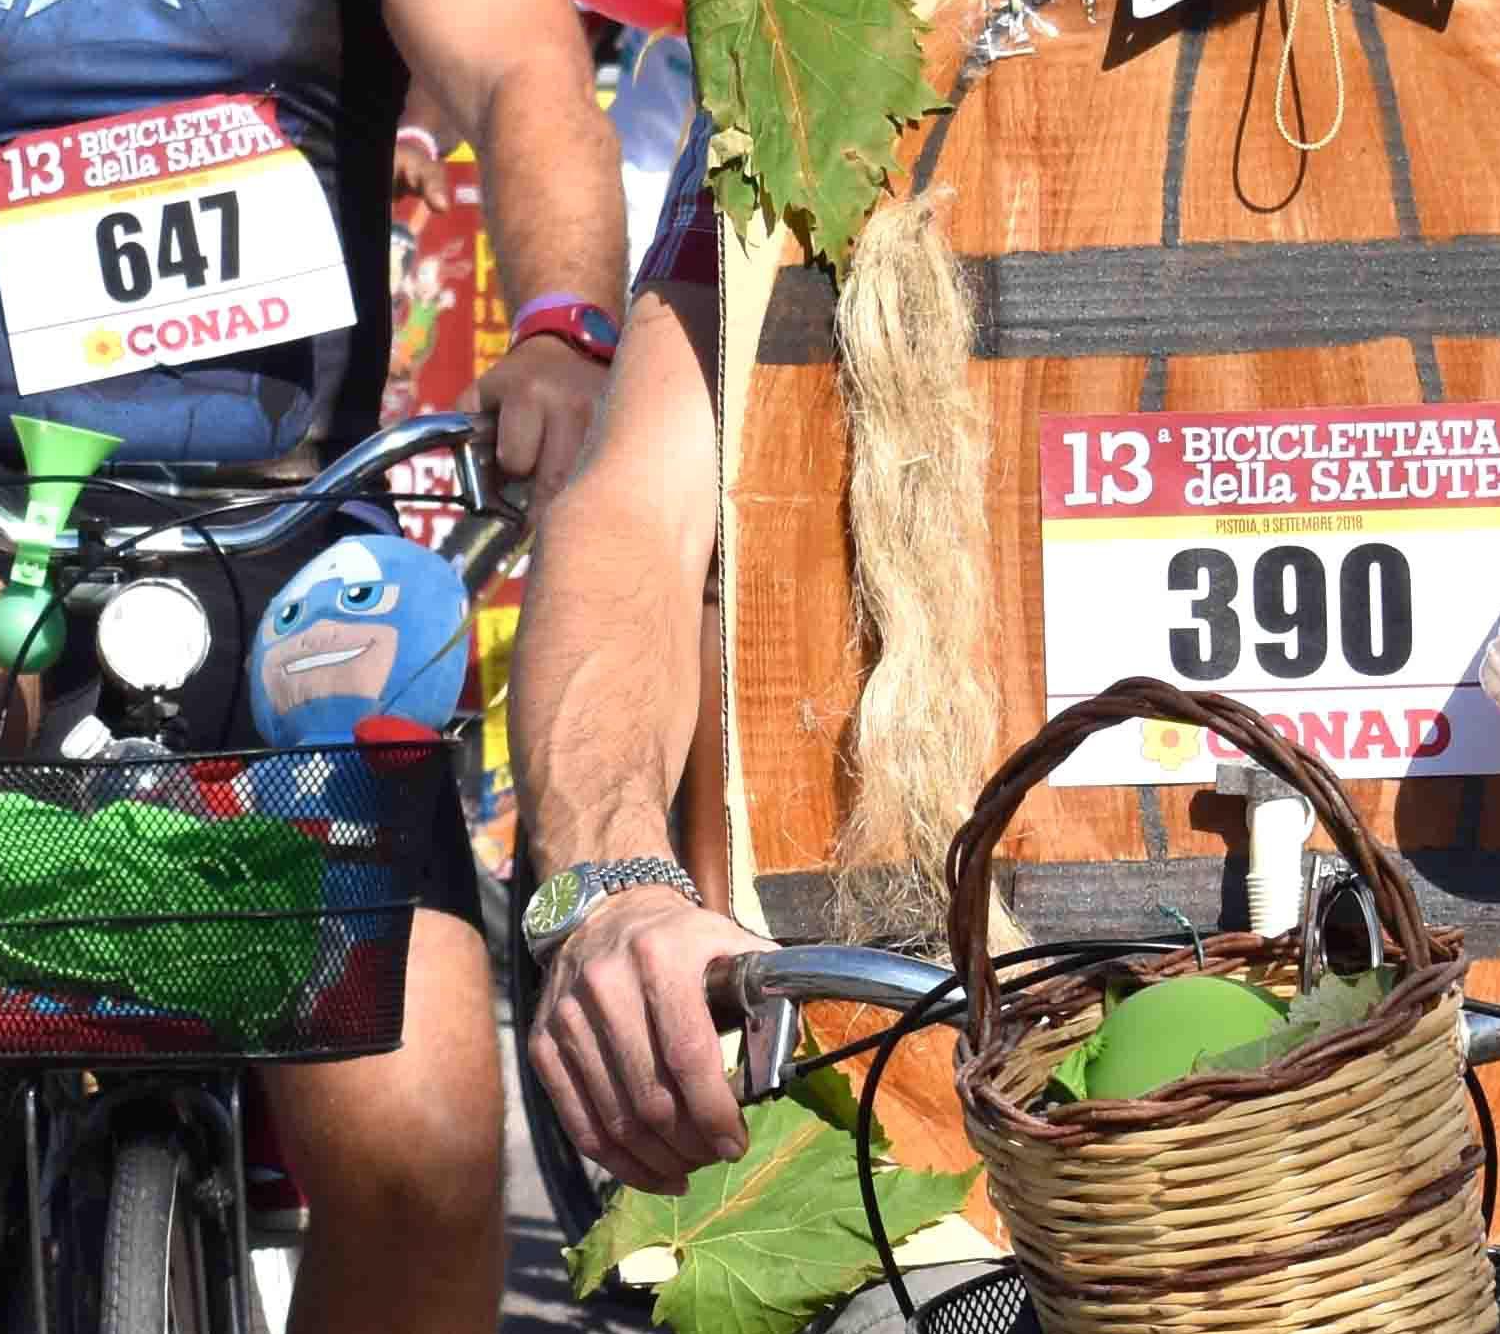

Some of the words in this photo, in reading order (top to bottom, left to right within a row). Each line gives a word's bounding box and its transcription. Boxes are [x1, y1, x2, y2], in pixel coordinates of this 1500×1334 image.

[84, 149, 160, 187] della
[96, 190, 240, 303] 647
[127, 297, 290, 357] CONAD
[1184, 462, 1297, 506] della
[1216, 517, 1260, 537] PISTOIA,
[1263, 517, 1271, 533] 9
[1272, 515, 1333, 534] SETTEMBRE
[1336, 514, 1364, 532] 2018
[1166, 542, 1412, 681] 390
